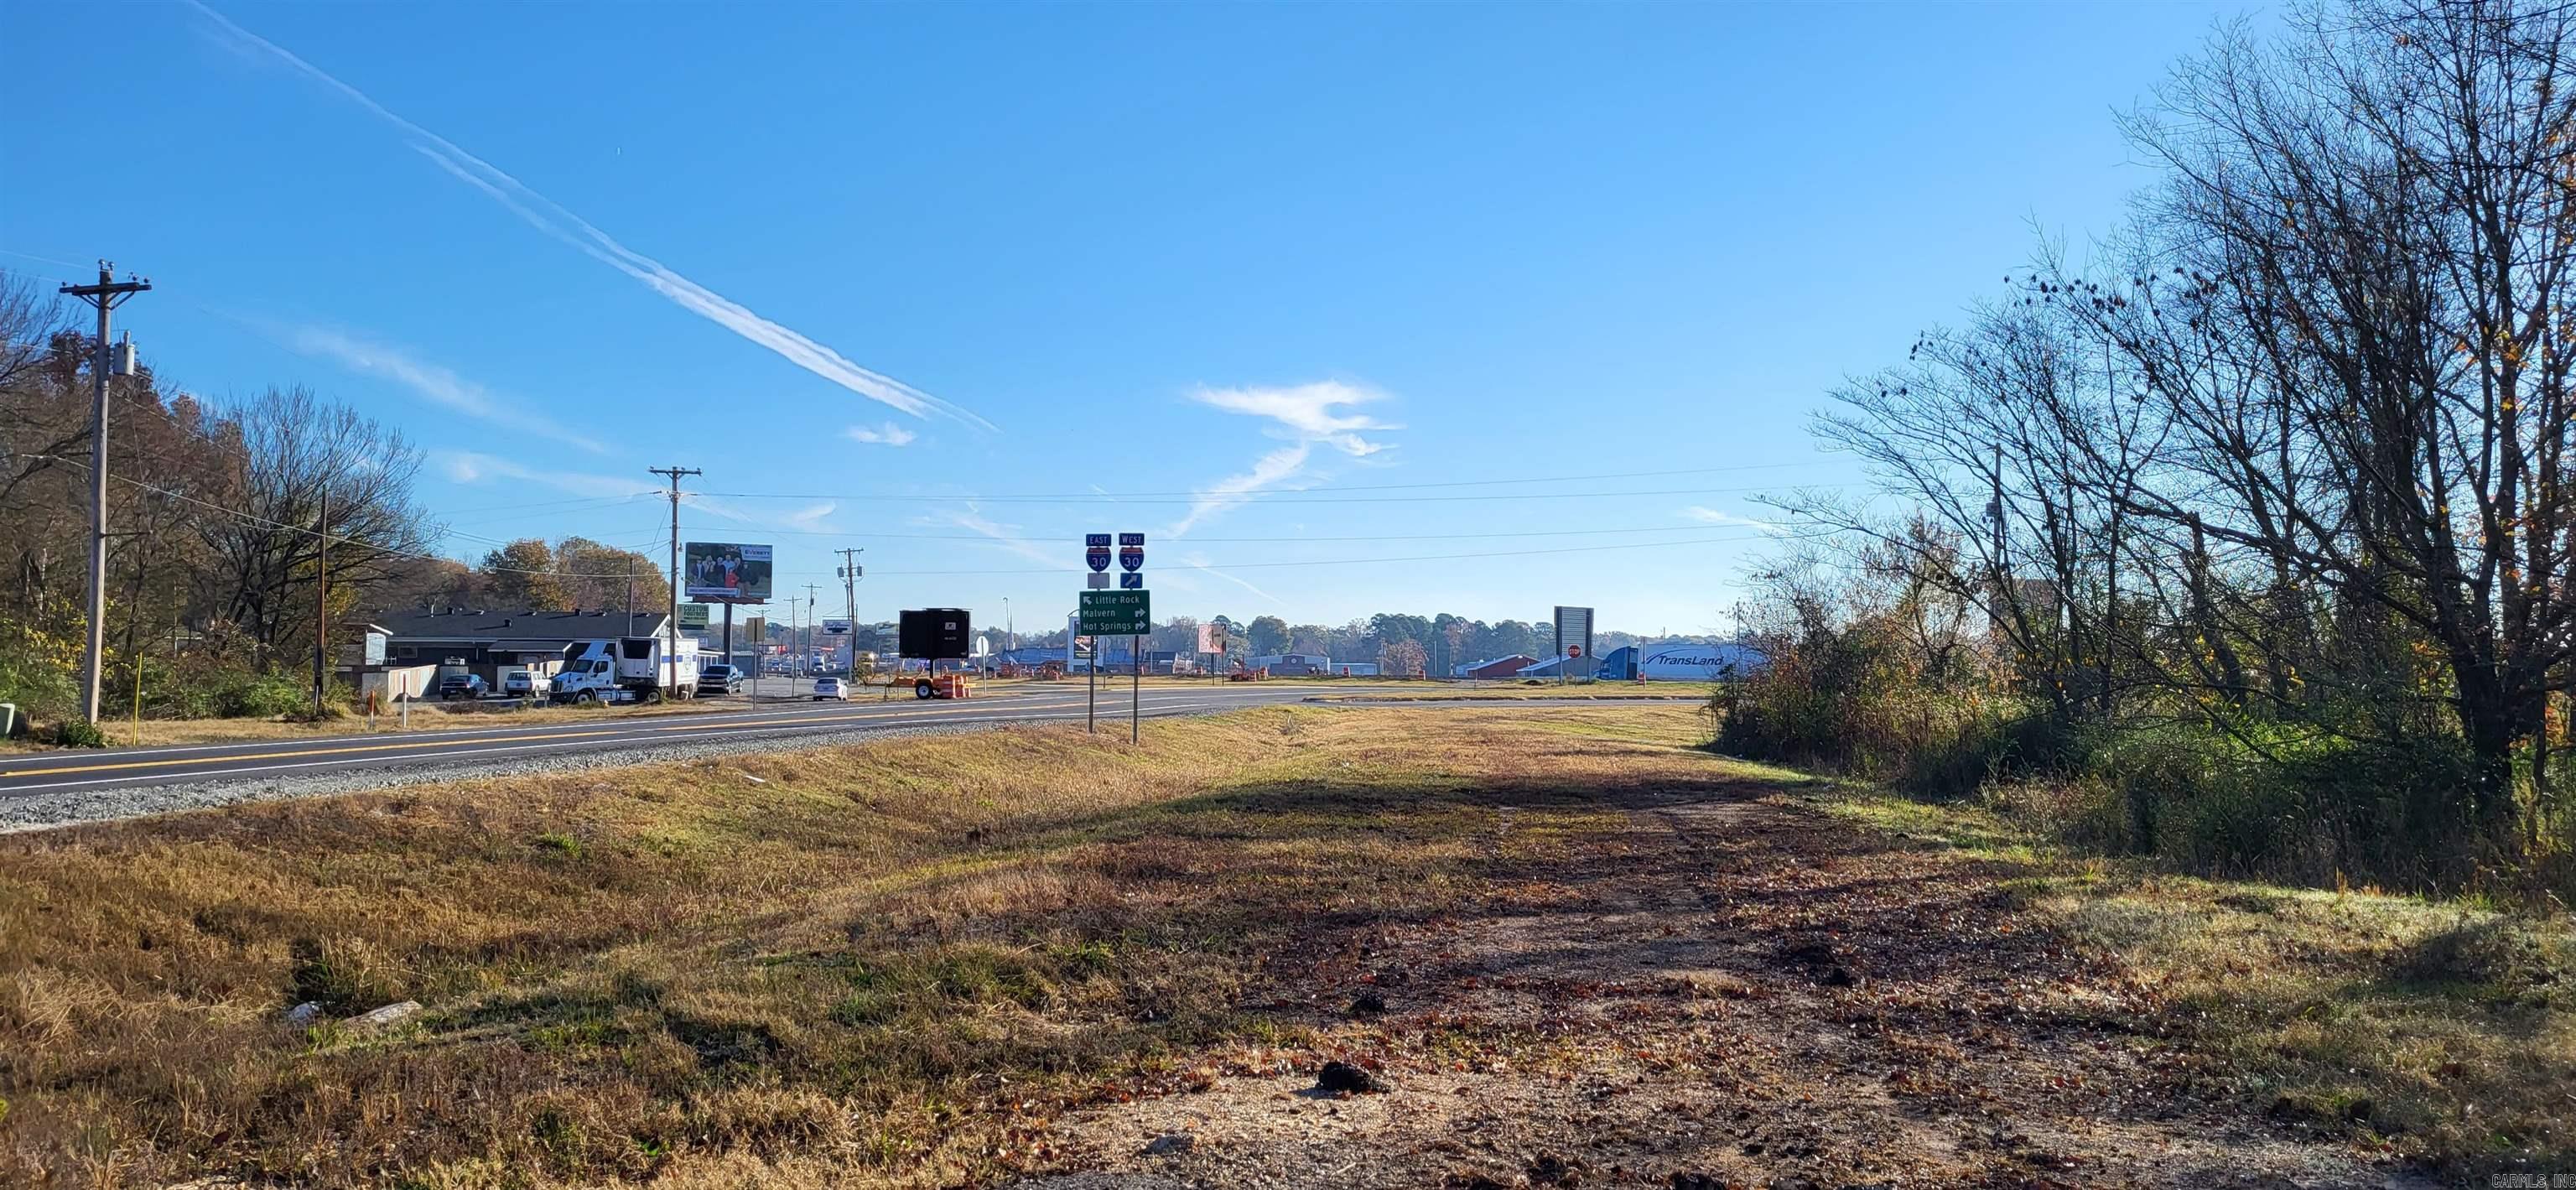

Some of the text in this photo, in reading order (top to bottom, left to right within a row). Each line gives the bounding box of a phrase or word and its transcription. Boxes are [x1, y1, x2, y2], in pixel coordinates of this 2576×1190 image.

[1089, 536, 1108, 544] EAST
[1122, 535, 1141, 544] WEST
[1092, 557, 1107, 567] 30
[1124, 557, 1140, 567] 30
[1095, 595, 1140, 604] Little Rock
[1083, 621, 1132, 631] Hot Springs
[1659, 656, 1724, 665] TransLand
